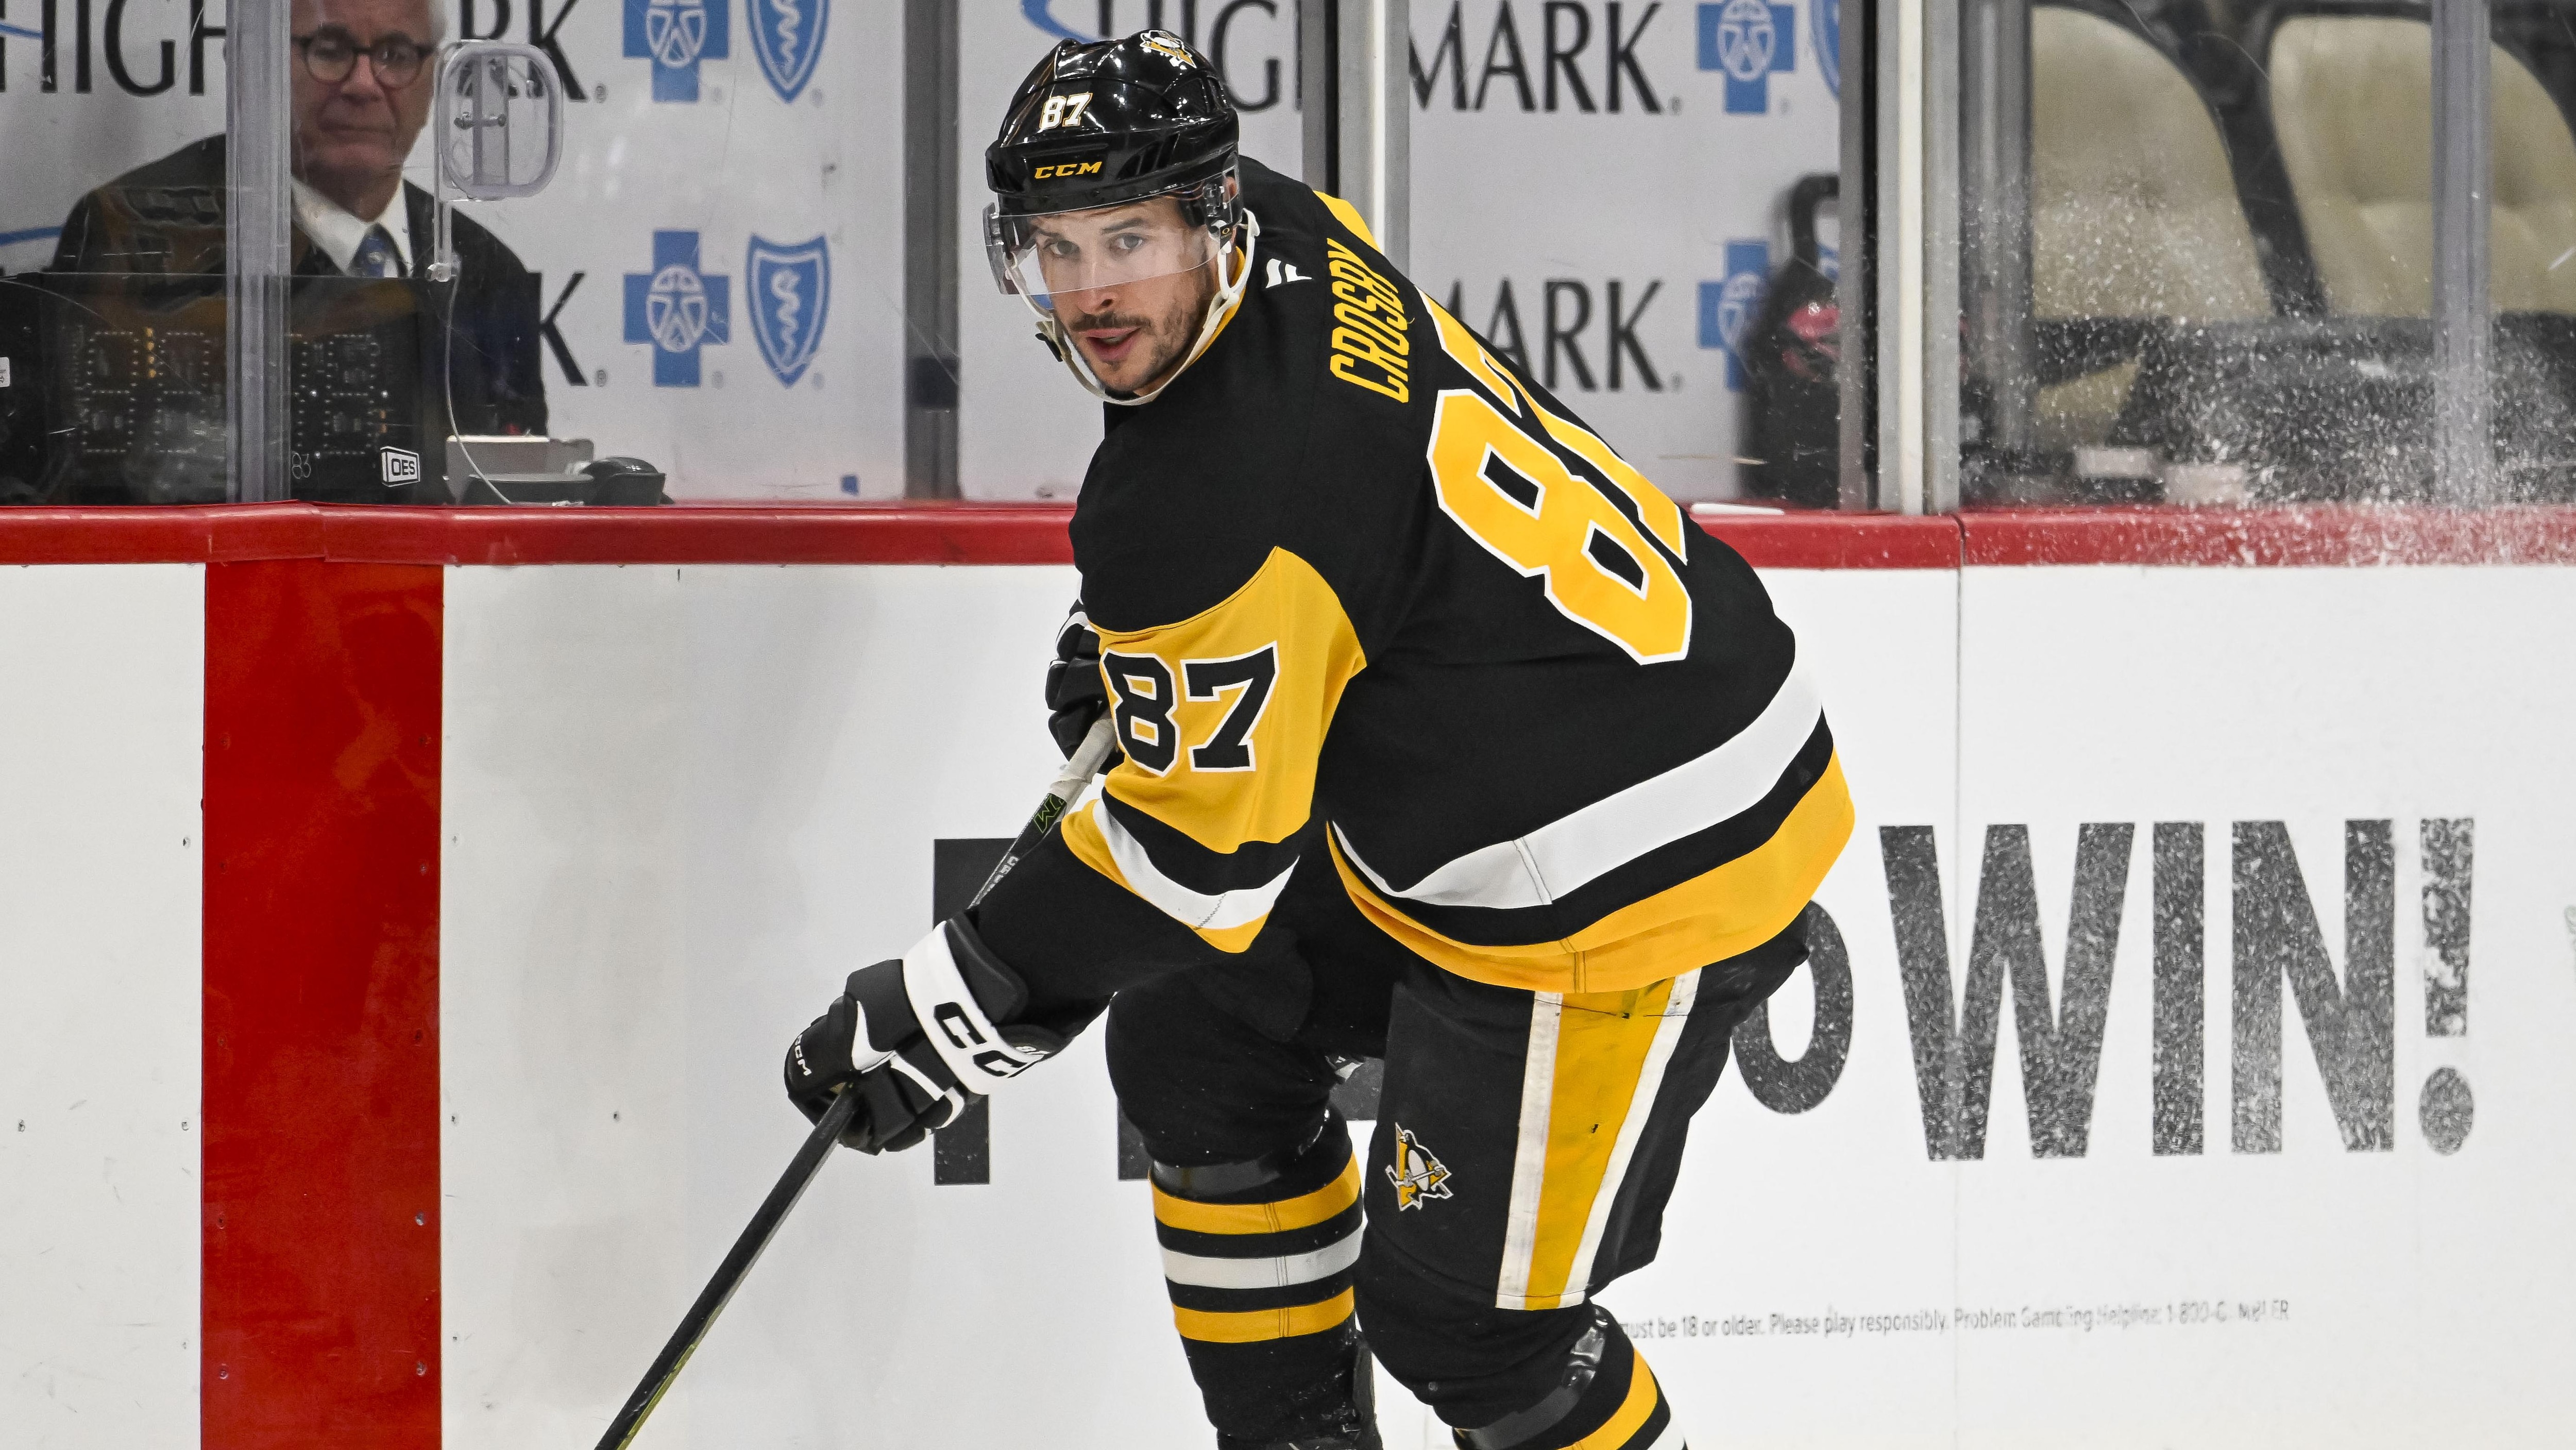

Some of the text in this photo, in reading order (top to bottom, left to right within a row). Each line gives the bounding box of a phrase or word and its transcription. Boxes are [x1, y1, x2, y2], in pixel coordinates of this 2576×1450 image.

[1039, 93, 1093, 129] 87
[1035, 161, 1102, 179] CCM
[1327, 238, 1410, 403] CROSBY
[1416, 286, 1692, 666] 87
[1100, 640, 1280, 777] 87
[934, 1002, 1045, 1078] CC
[1878, 818, 2475, 1160] WIN!
[1658, 1316, 1677, 1338] be
[1683, 1315, 1698, 1337] 18
[1702, 1320, 1717, 1337] or
[1769, 1312, 1819, 1335] Please
[1824, 1309, 1856, 1339] play
[1954, 1306, 2016, 1329] Problem
